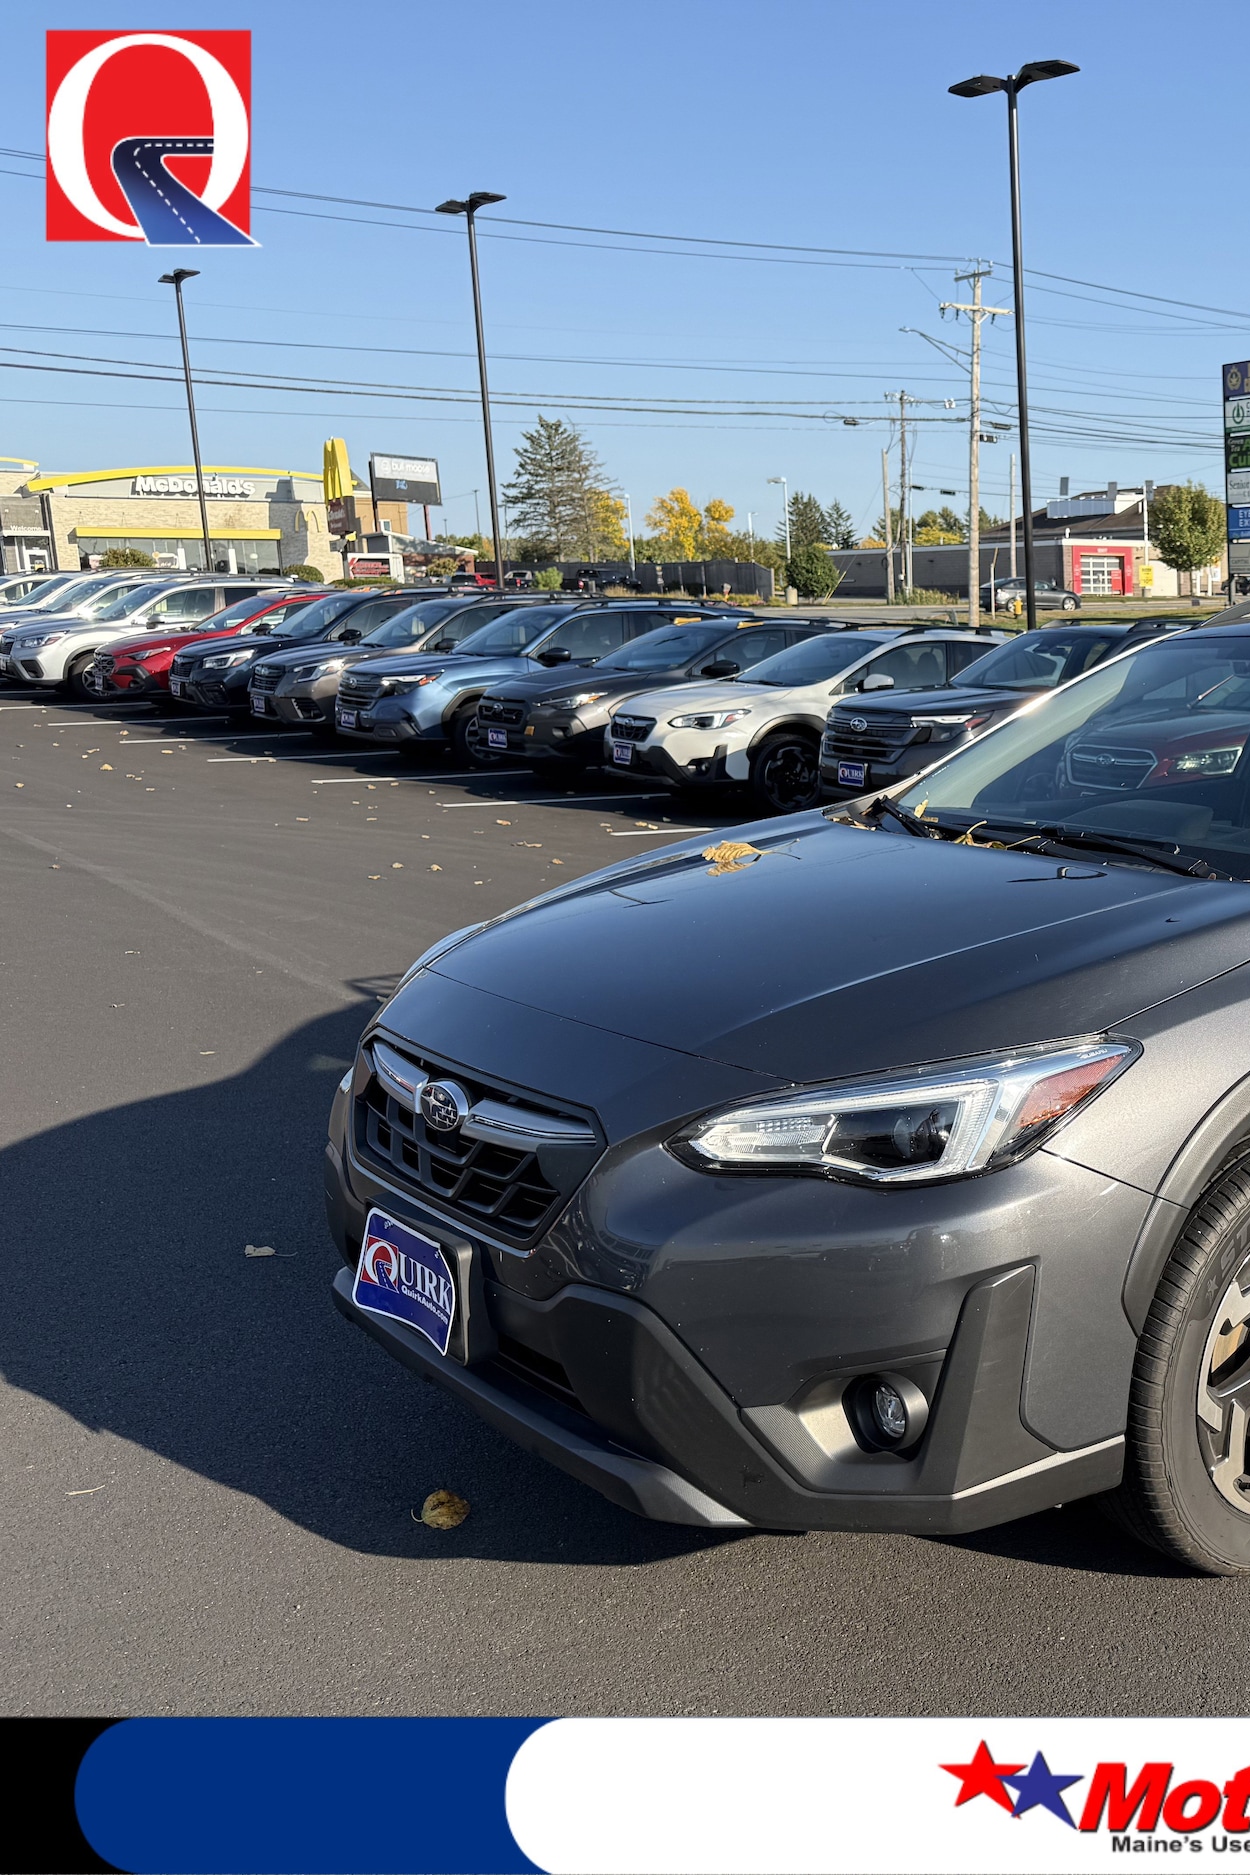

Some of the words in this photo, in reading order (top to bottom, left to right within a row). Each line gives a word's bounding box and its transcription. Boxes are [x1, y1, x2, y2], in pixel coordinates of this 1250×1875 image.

[1229, 480, 1250, 490] Senior
[362, 1241, 451, 1315] QUIRK
[401, 1284, 448, 1325] QuirkAuto.com
